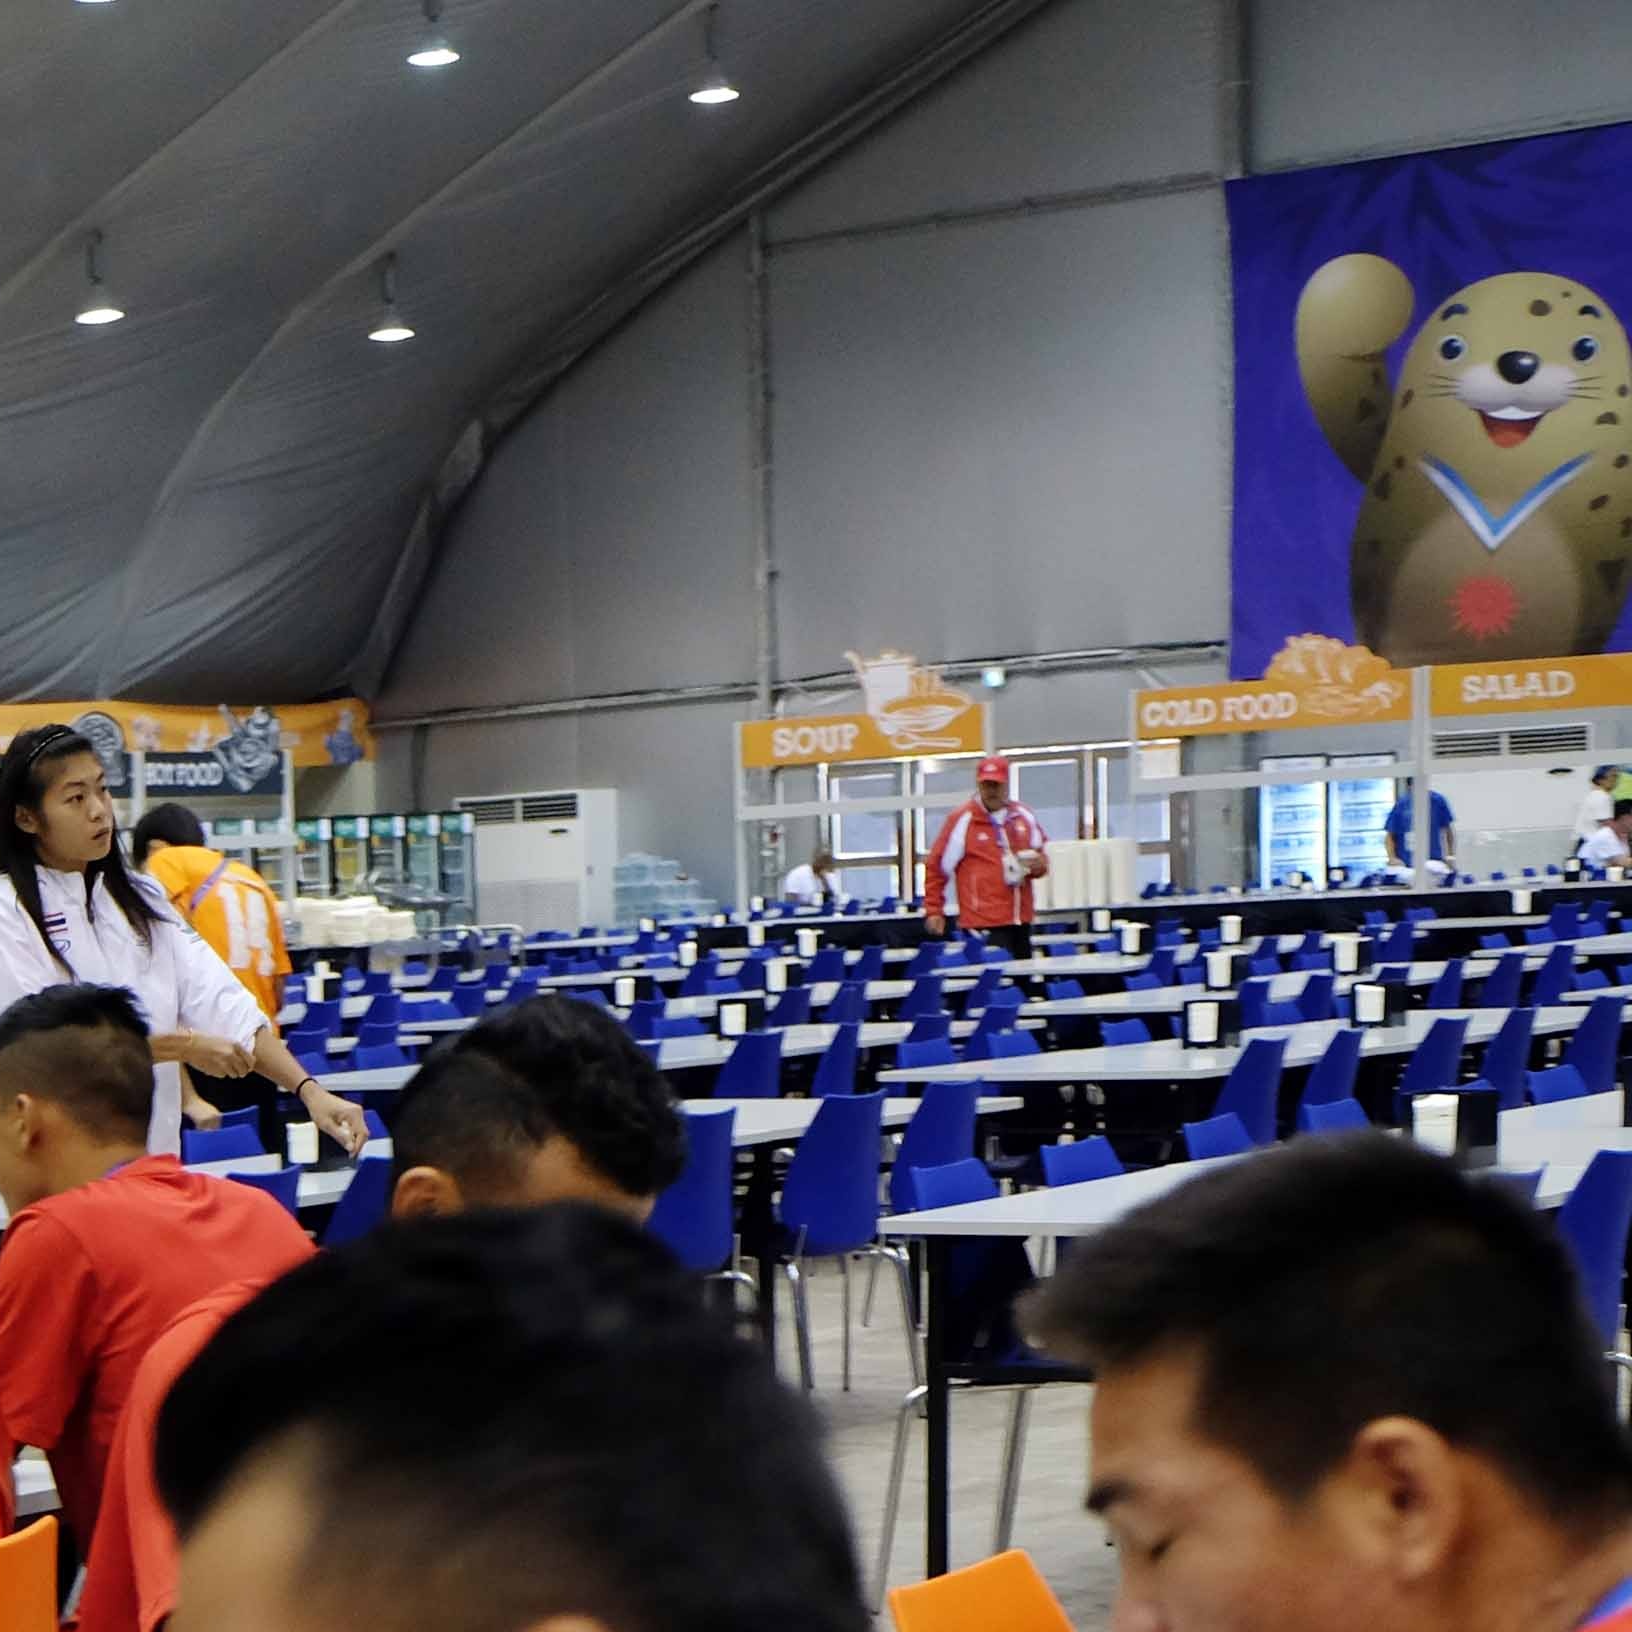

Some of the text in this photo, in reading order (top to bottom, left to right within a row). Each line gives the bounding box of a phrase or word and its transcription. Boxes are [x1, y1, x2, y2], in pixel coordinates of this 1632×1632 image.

[1461, 671, 1575, 702] SALAD
[1142, 692, 1298, 728] COLD FOOD
[771, 723, 859, 757] SOUP
